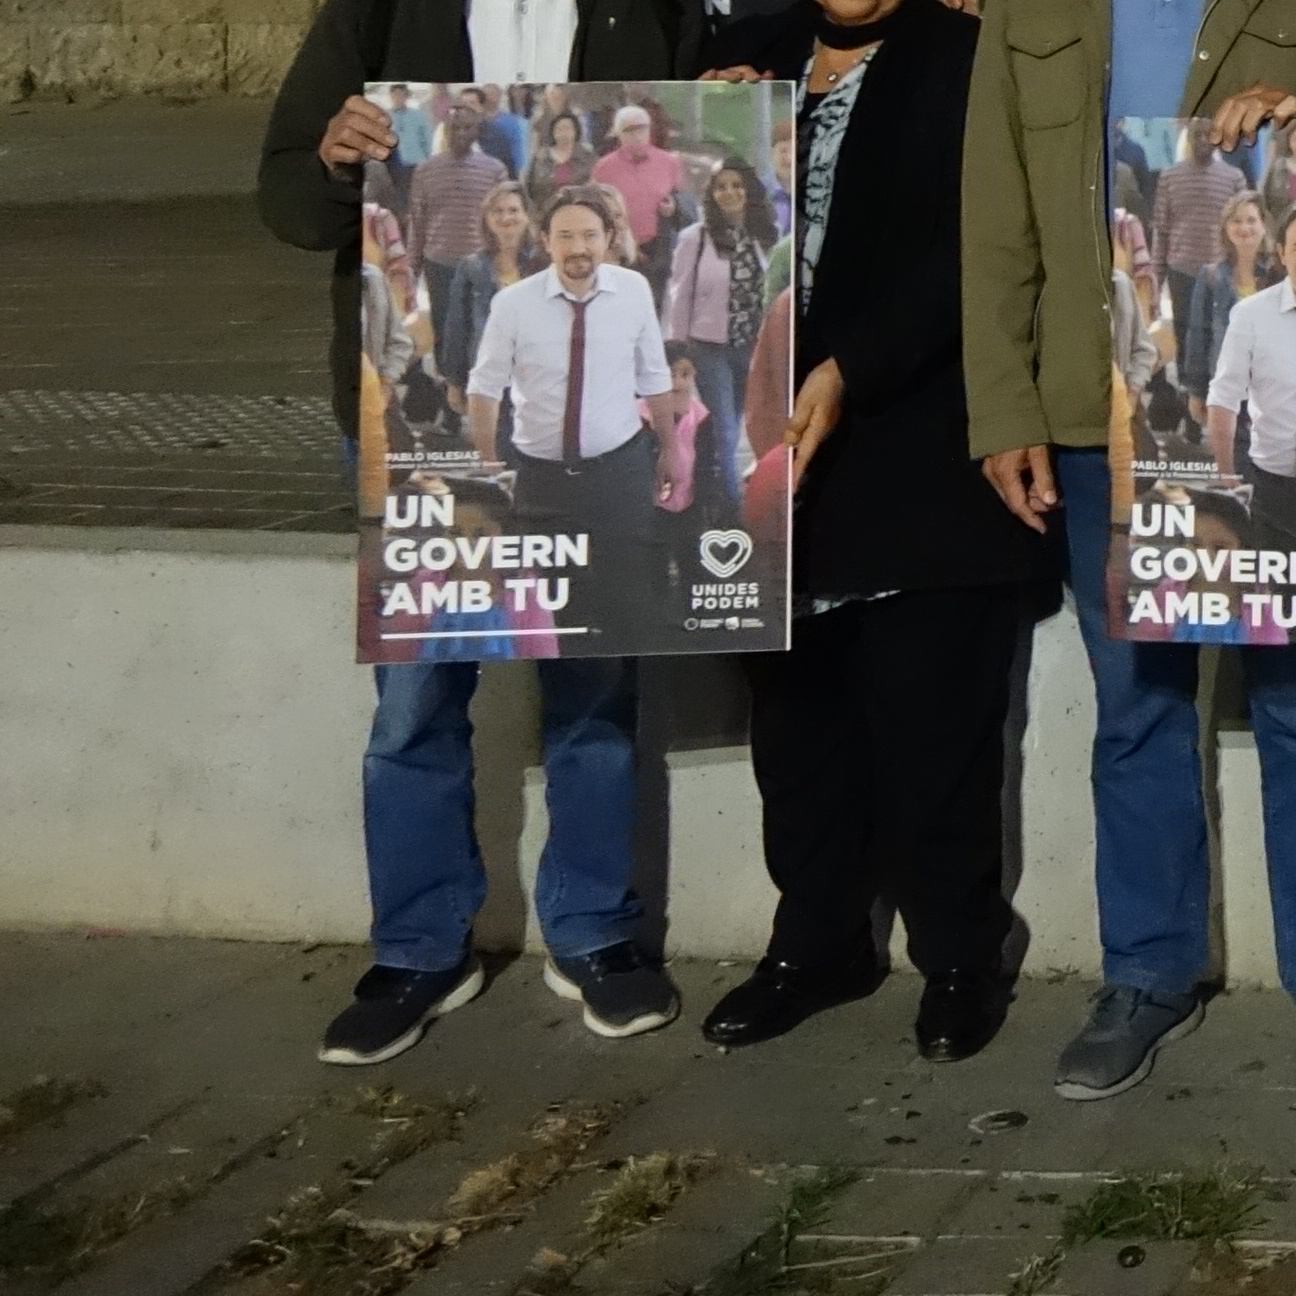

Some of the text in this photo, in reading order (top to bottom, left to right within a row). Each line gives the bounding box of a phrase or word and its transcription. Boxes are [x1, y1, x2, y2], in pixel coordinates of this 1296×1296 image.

[384, 450, 481, 462] PABLO IGLESIAS
[1131, 460, 1219, 472] PABLO IGLESIAS
[383, 494, 455, 529] UN
[1130, 504, 1196, 538] UN
[383, 534, 589, 573] GOVERN
[380, 577, 570, 616] AMB TU
[691, 583, 760, 596] UNIDES
[691, 596, 759, 610] PODEM
[1128, 589, 1231, 626] AMB
